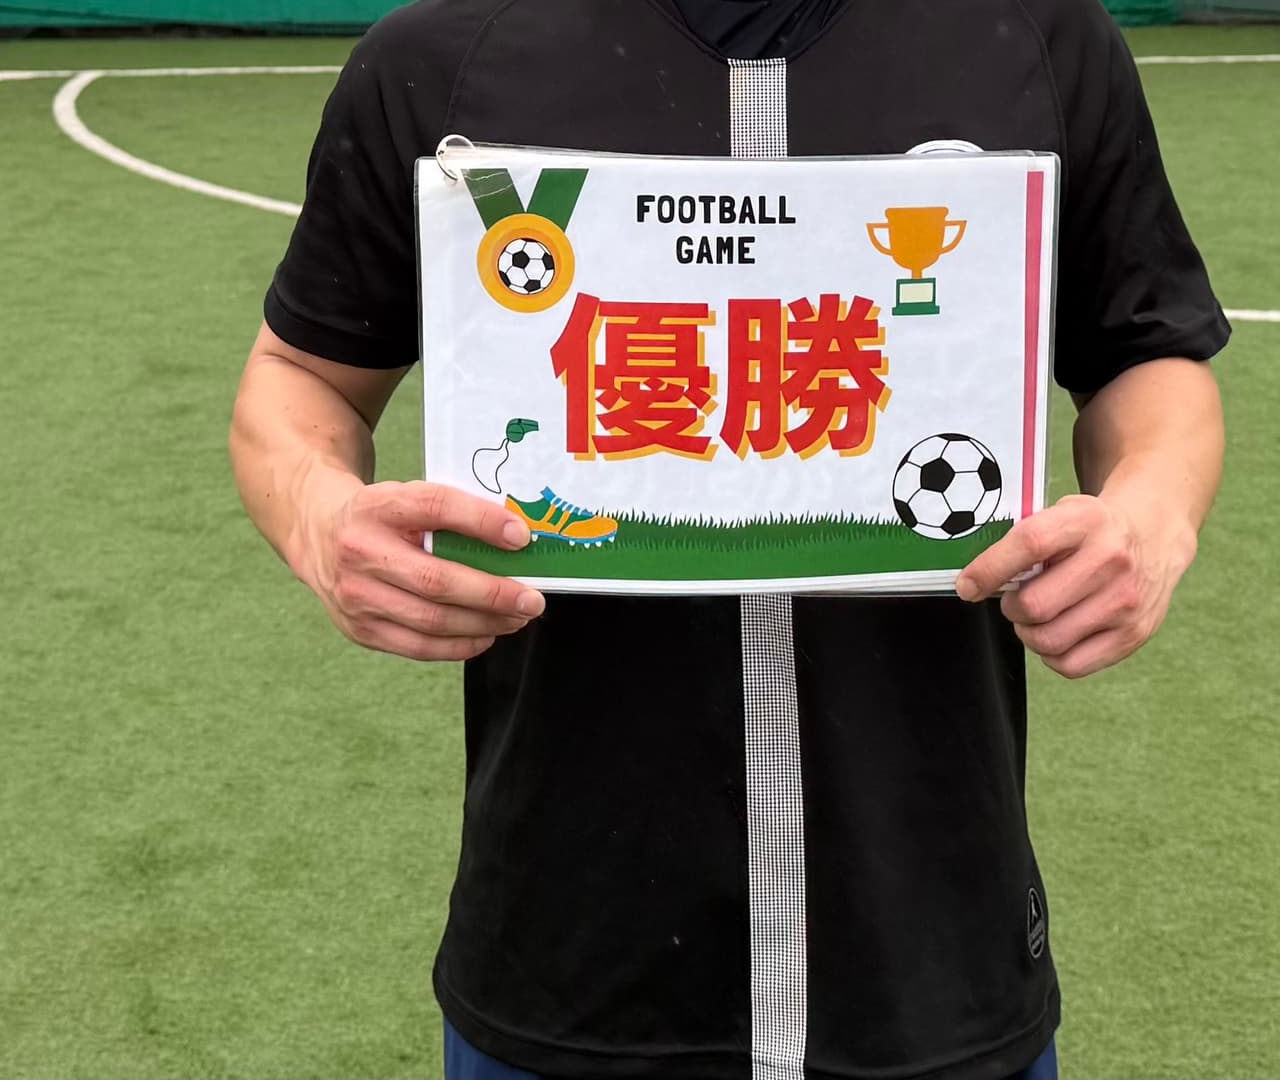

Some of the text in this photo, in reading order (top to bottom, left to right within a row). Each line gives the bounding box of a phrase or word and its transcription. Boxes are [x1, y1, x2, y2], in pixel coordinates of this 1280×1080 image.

[636, 194, 796, 225] FOOTBALL
[675, 235, 756, 265] GAME
[550, 292, 892, 461] 優勝
